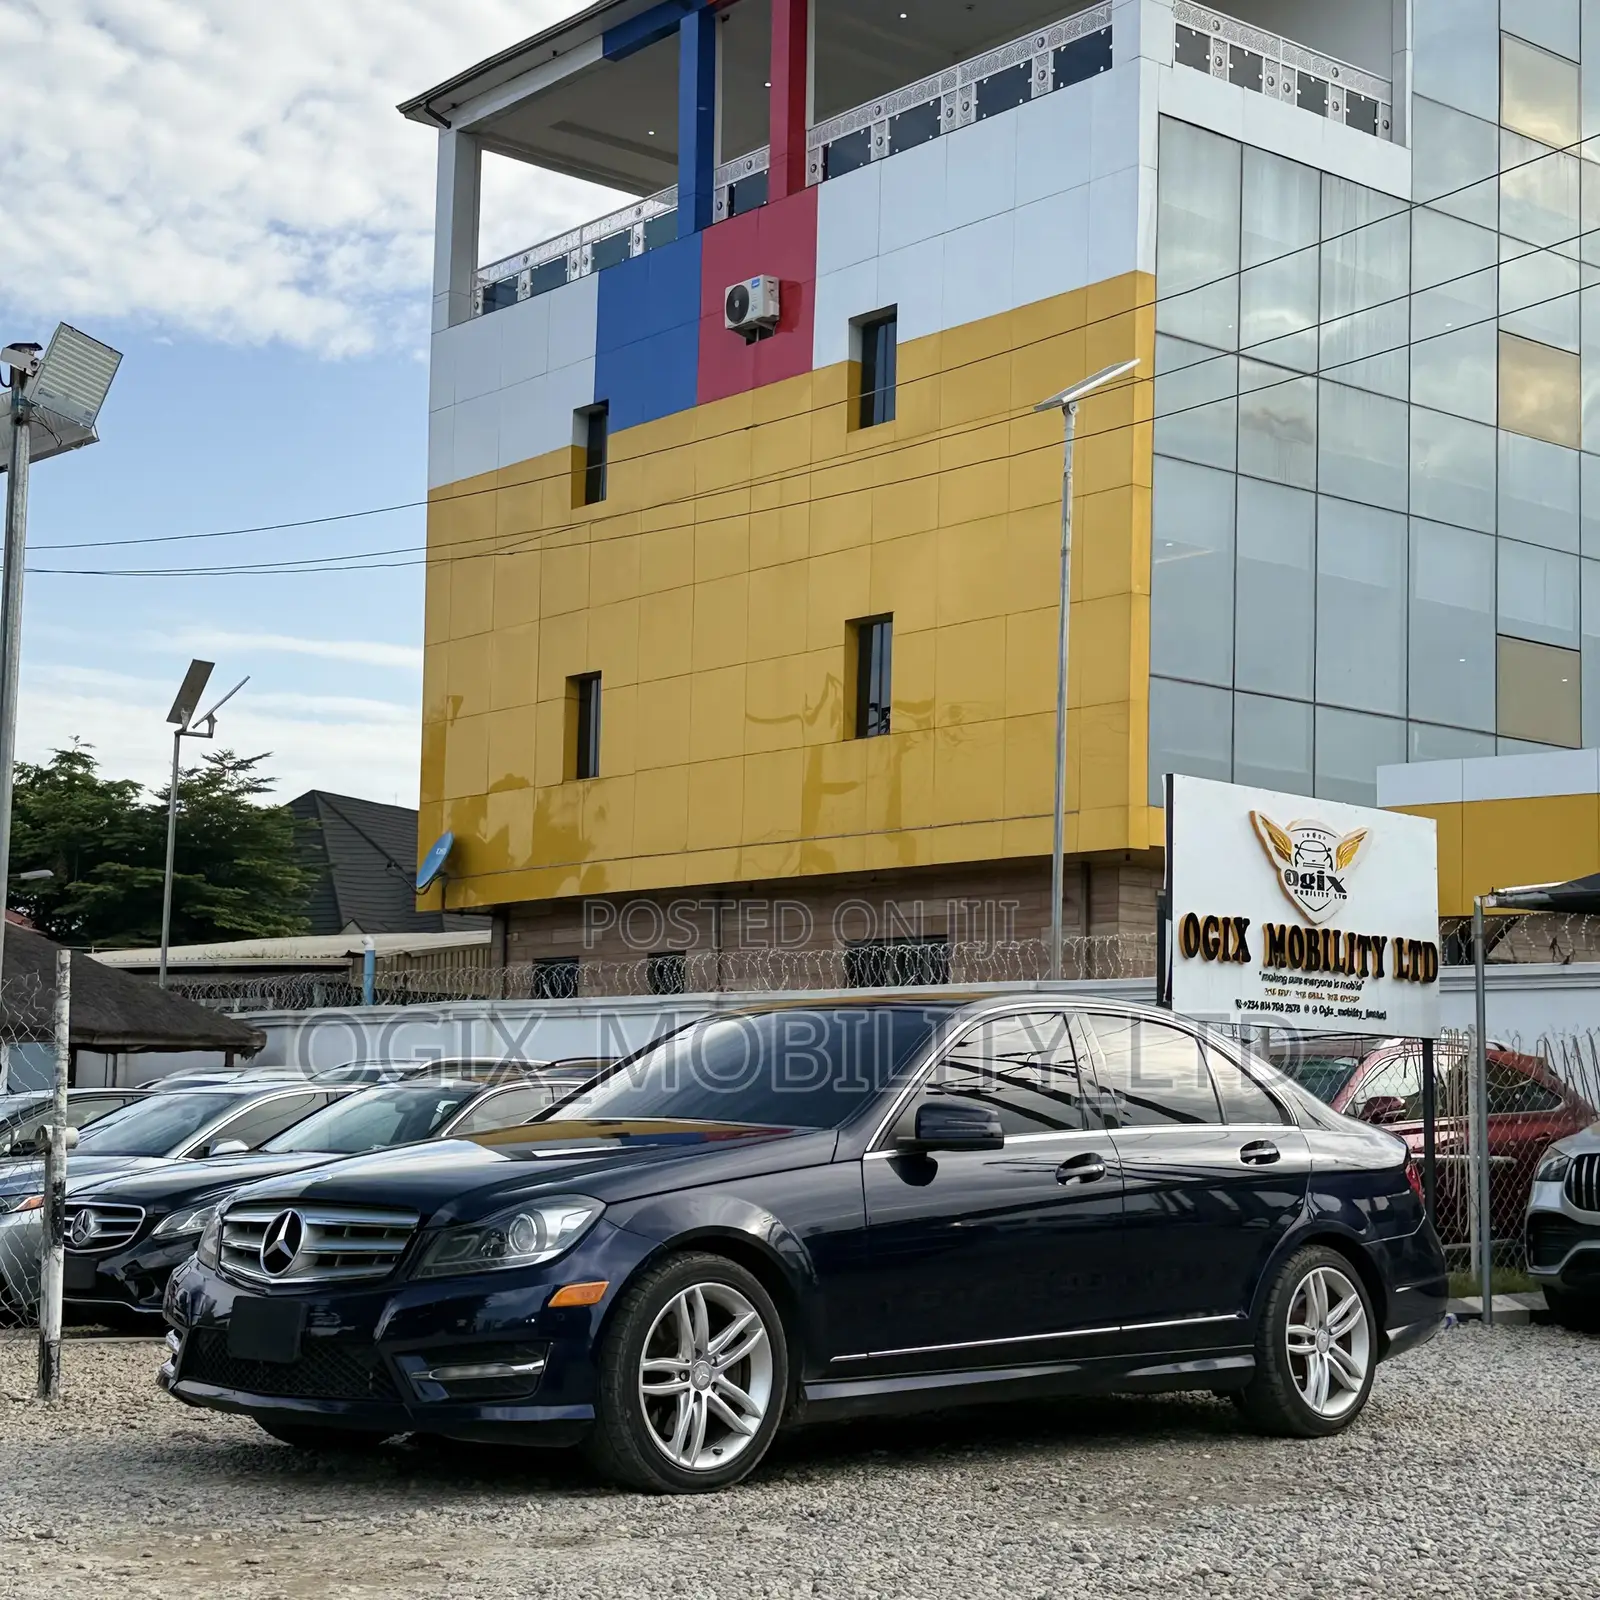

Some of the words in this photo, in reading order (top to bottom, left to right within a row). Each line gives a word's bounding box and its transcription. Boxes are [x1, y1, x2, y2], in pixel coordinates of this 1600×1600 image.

[1179, 912, 1251, 963] OGIX
[1262, 922, 1388, 979] MOBILITY
[1391, 937, 1439, 983] LTD
